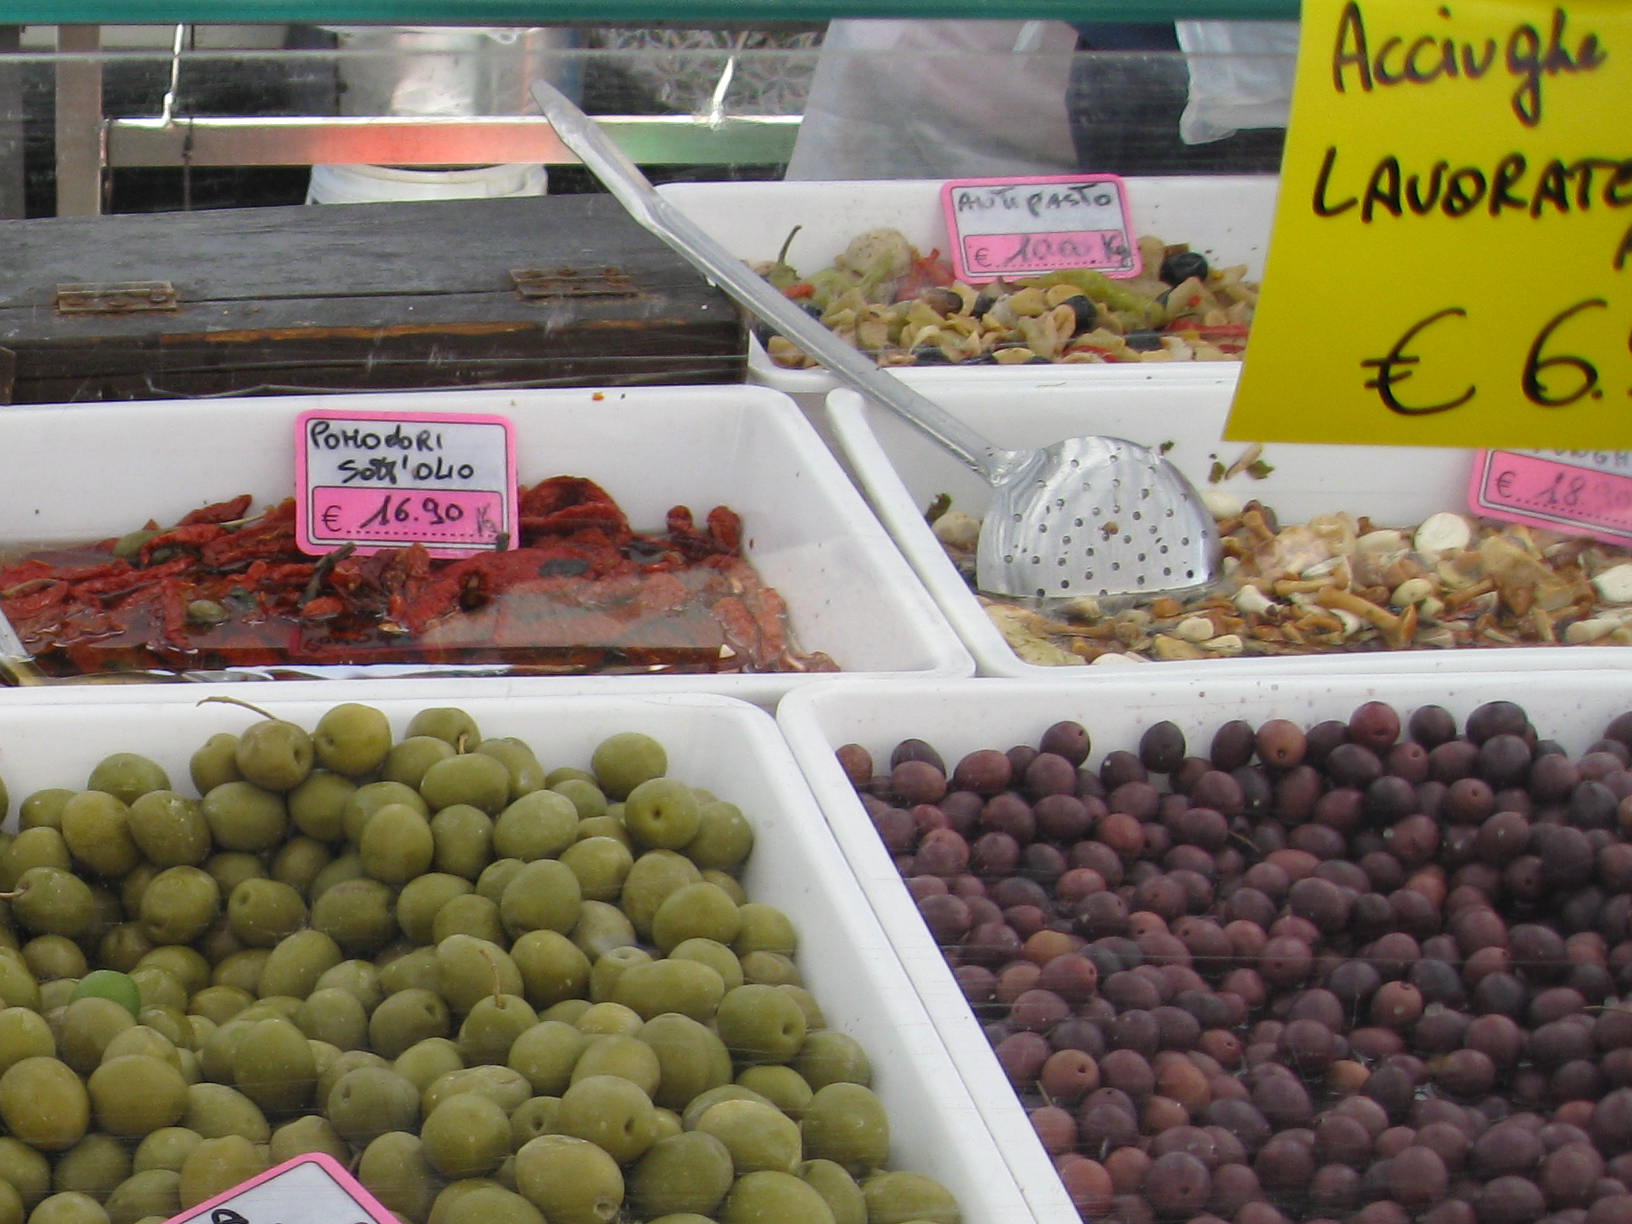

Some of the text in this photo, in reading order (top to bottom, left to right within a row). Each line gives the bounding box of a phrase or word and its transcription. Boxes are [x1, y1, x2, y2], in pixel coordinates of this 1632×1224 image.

[1332, 1, 1607, 127] Acciughe
[974, 247, 992, 268] €
[1360, 298, 1632, 415] € 6.
[1495, 470, 1517, 498] €
[321, 504, 343, 533] €
[359, 494, 464, 530] 16.90
